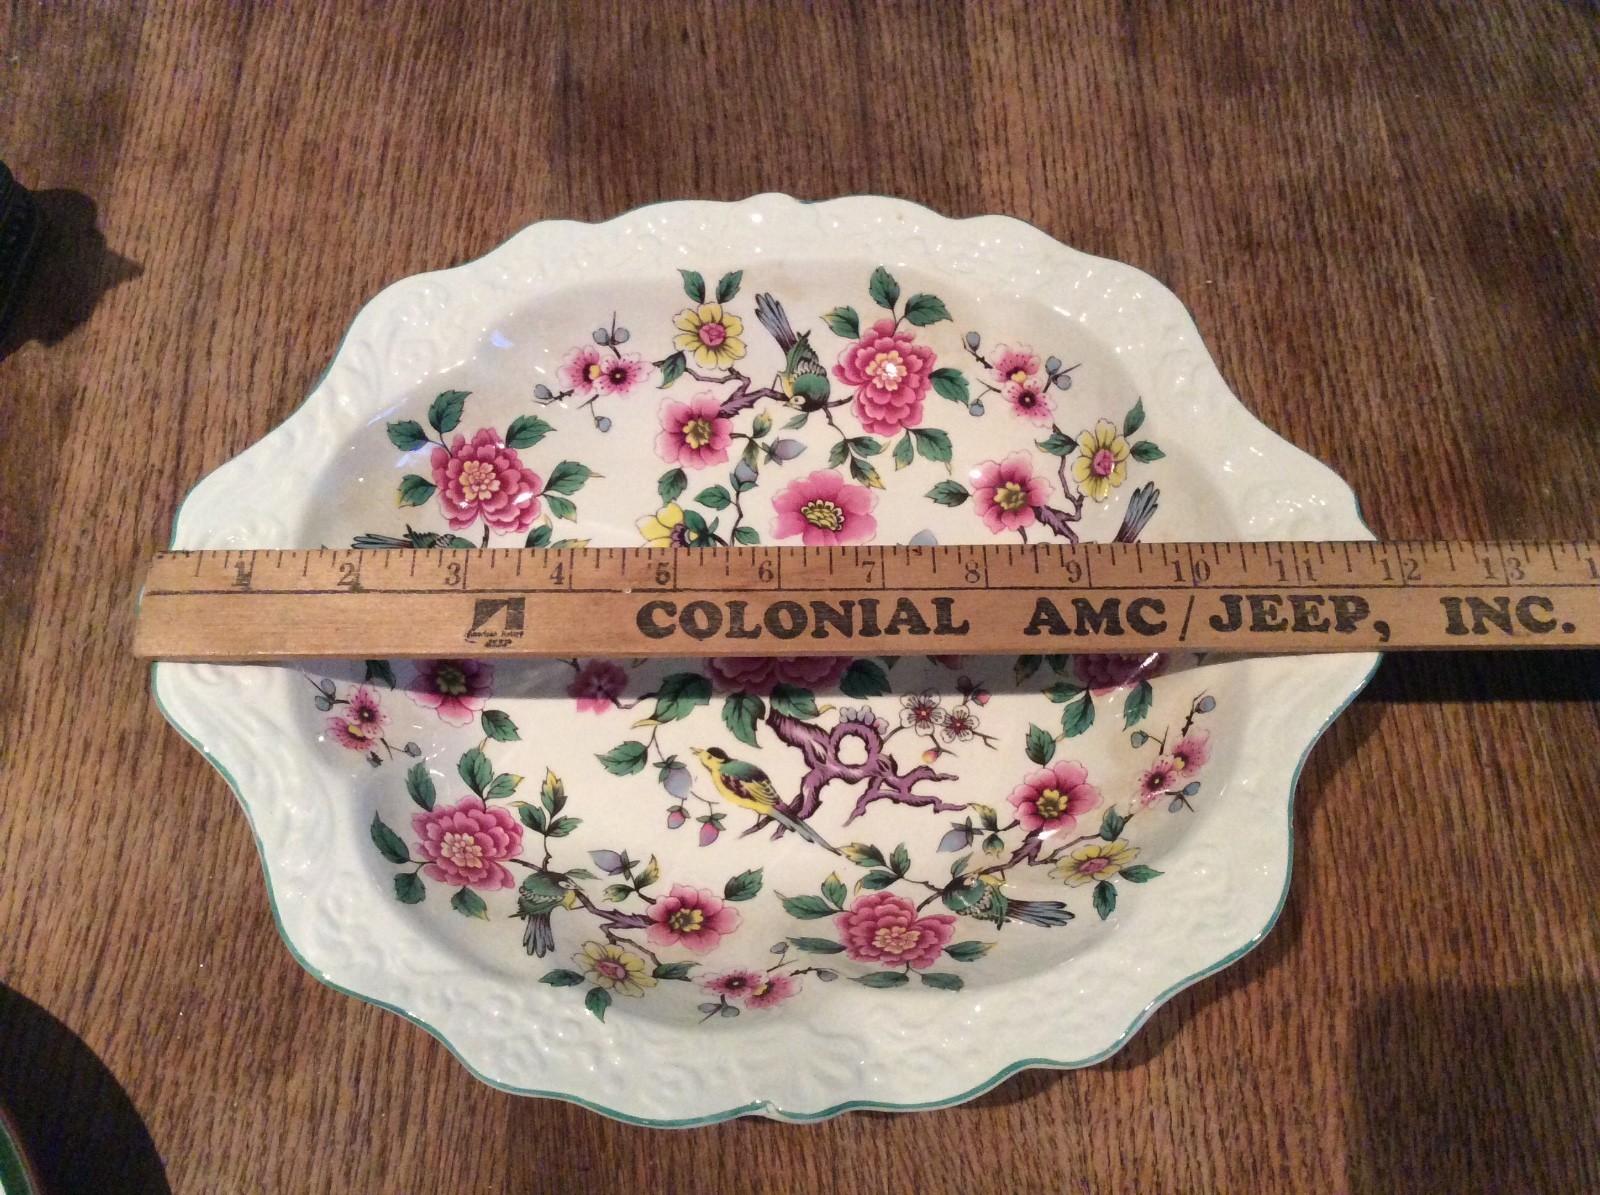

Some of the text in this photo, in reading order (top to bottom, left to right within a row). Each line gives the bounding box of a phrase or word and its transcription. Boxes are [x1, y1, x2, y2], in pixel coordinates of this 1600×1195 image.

[232, 561, 252, 587] 1
[337, 562, 357, 587] 2
[445, 562, 461, 586] 3
[549, 562, 564, 585] 4
[655, 561, 671, 586] 5
[758, 560, 774, 583] 6
[861, 560, 876, 584] 7
[964, 559, 981, 584] 8
[1065, 559, 1082, 583] 9
[1171, 559, 1211, 583] 10
[1275, 558, 1318, 582] 11
[1380, 558, 1422, 581] 12
[1481, 557, 1526, 580] 13
[636, 597, 970, 640] COLONIAL
[1440, 595, 1576, 636] INC.
